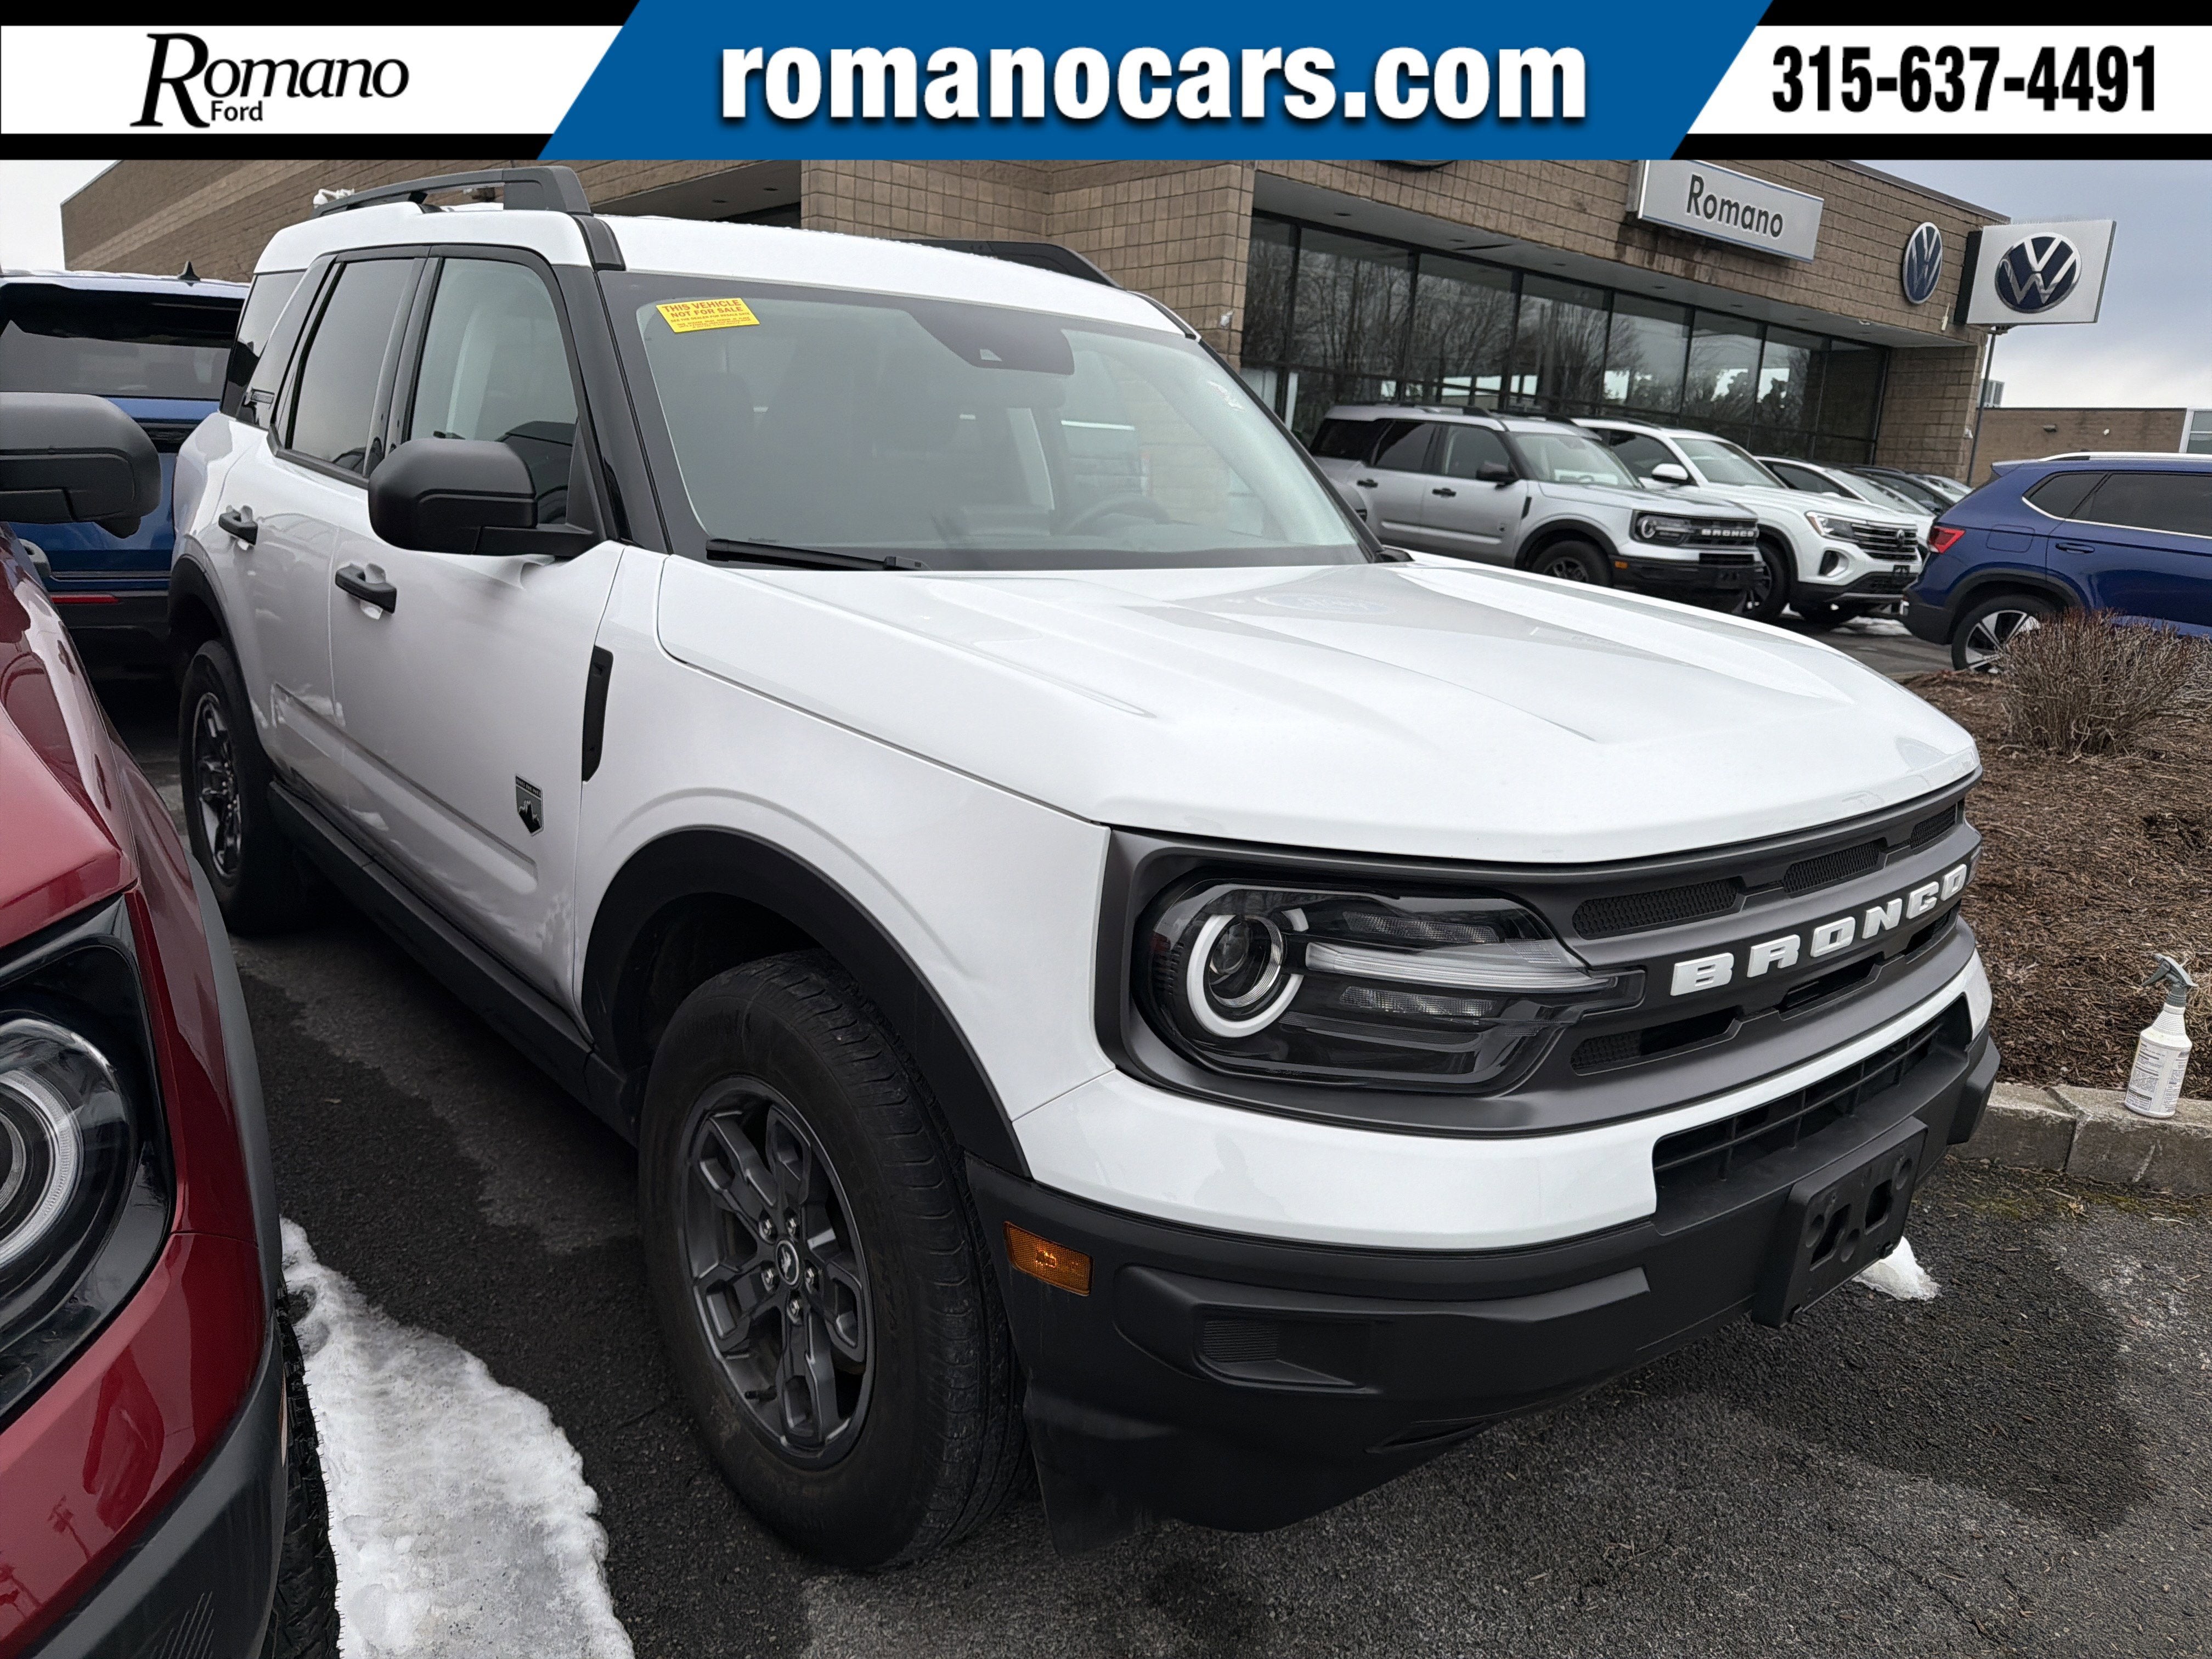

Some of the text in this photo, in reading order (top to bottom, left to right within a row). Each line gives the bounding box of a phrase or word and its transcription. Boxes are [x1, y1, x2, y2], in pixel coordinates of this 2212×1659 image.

[1686, 174, 1783, 238] Romano
[662, 300, 741, 313] THIS VEHICLE
[1671, 864, 1968, 996] BRONCO
